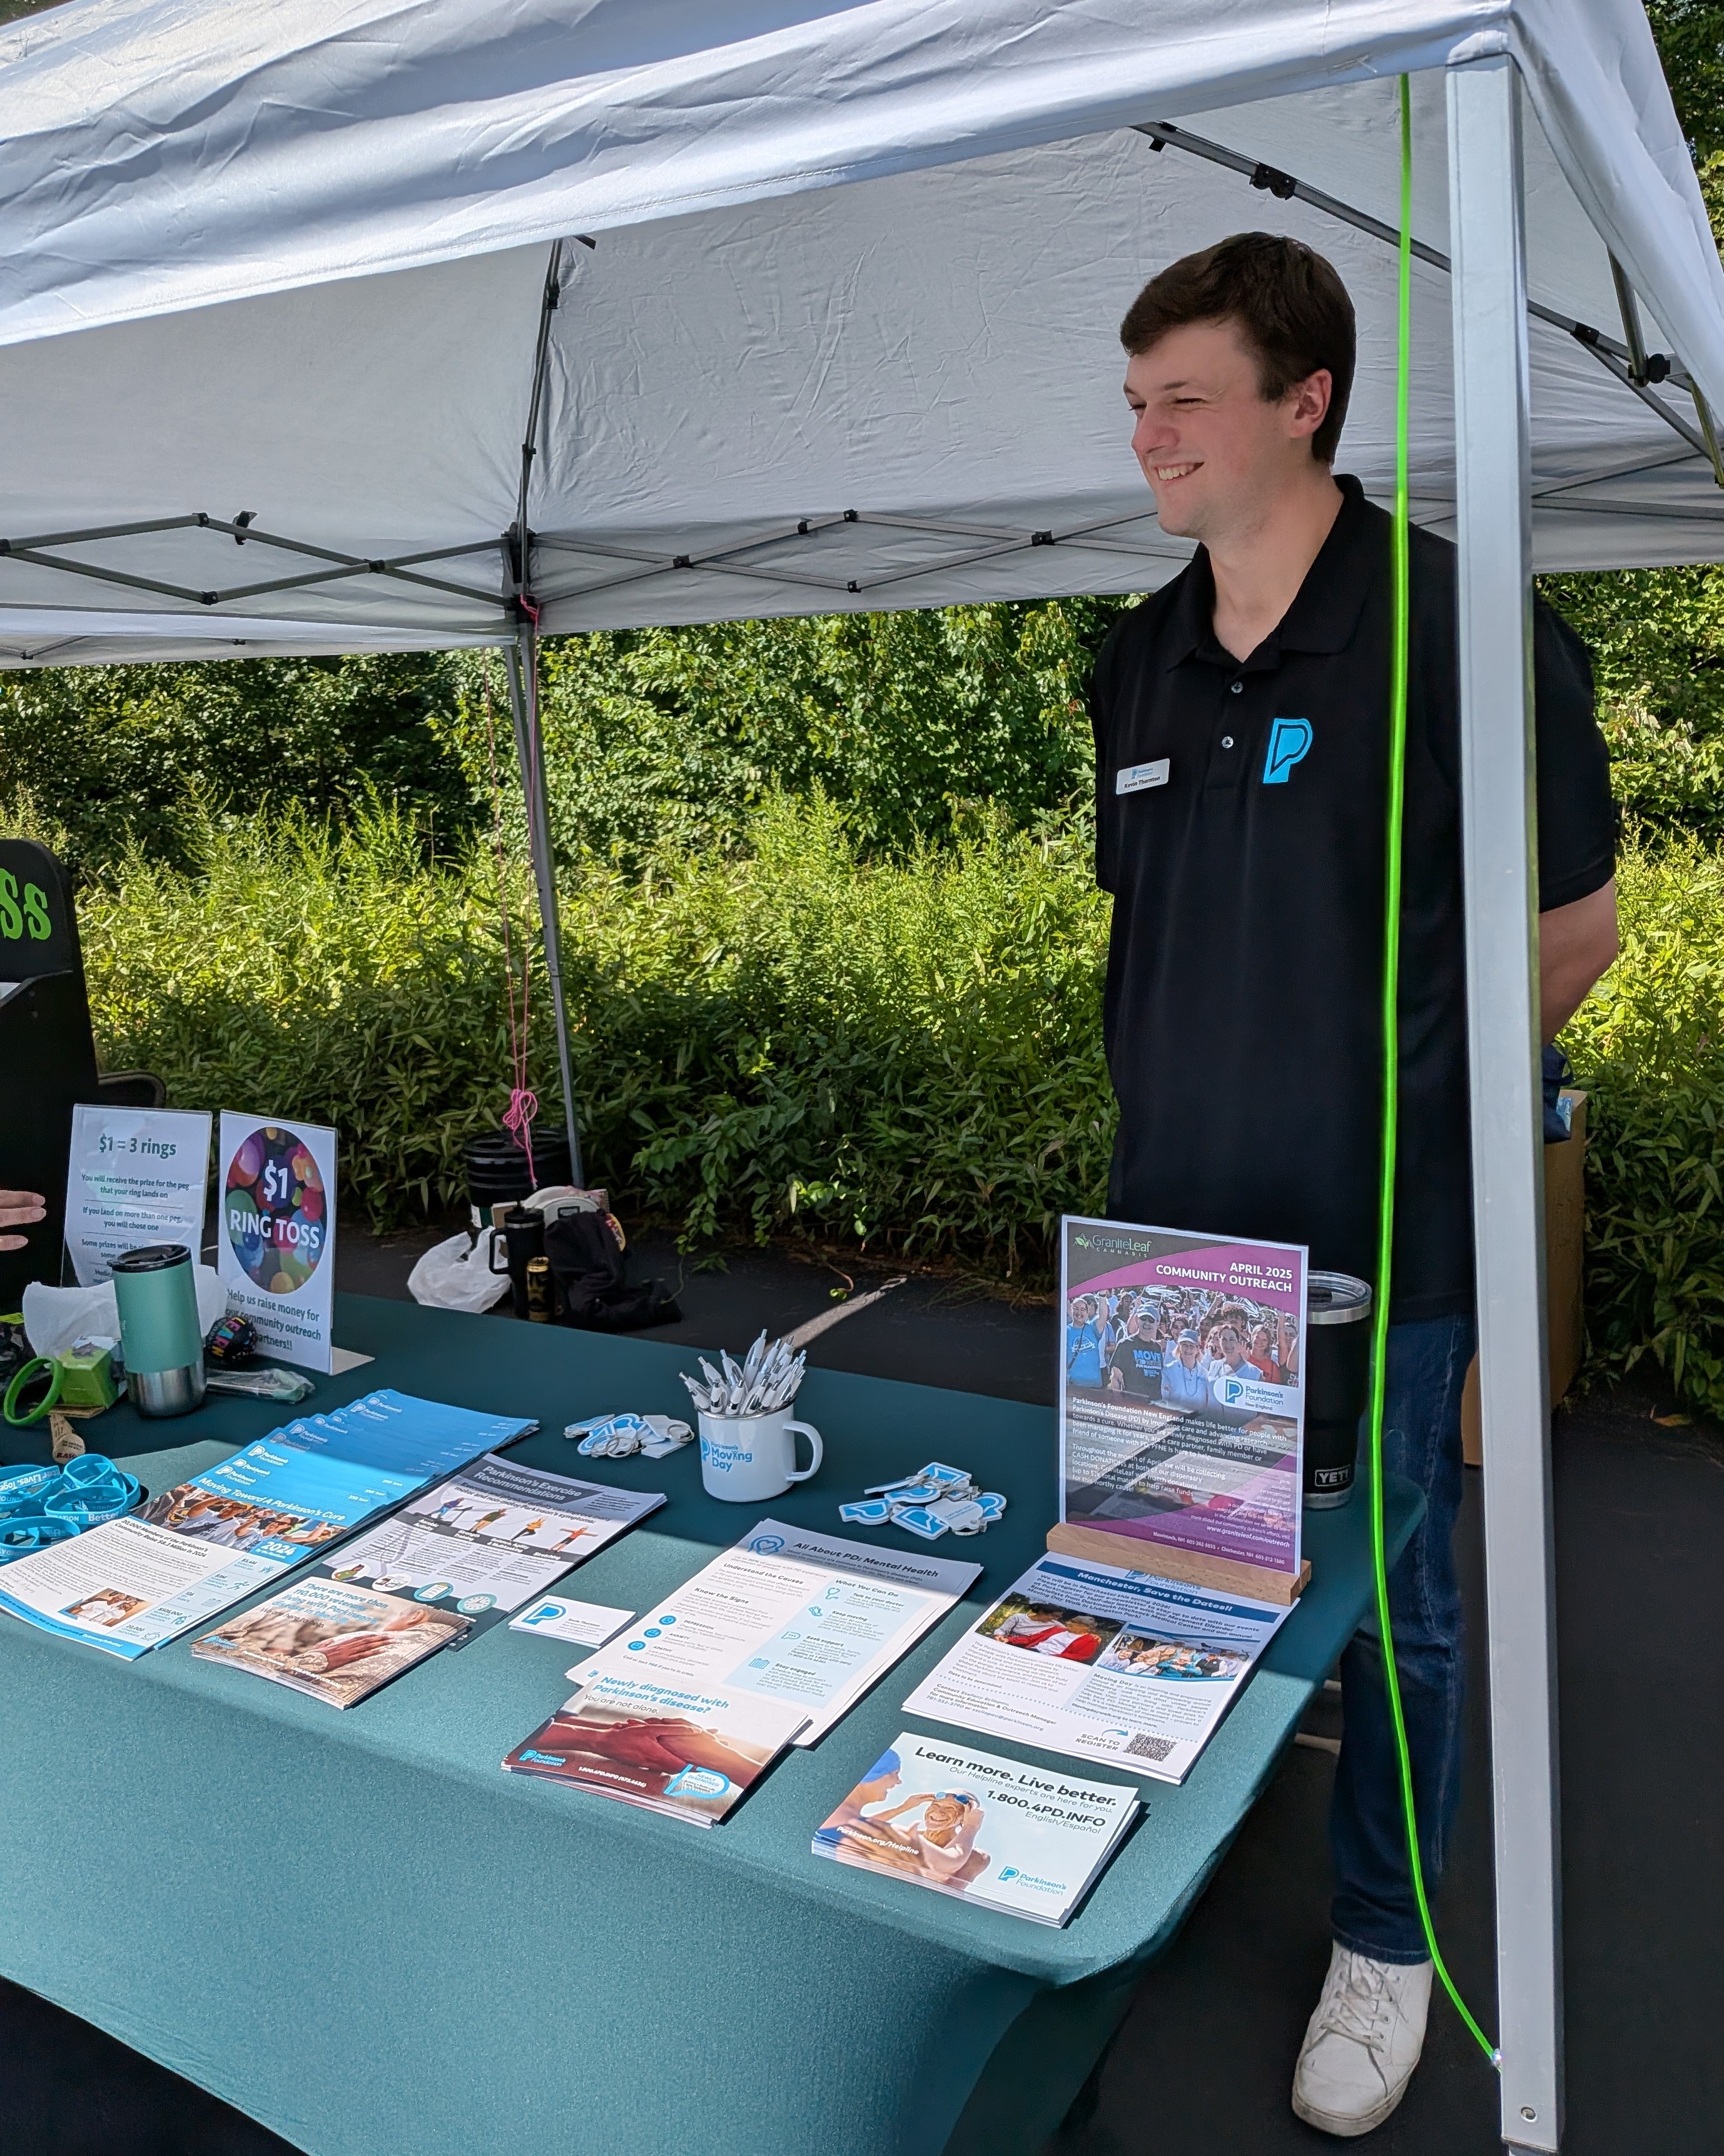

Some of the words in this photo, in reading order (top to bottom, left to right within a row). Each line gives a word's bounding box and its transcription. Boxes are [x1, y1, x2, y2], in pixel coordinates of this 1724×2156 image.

[1138, 776, 1160, 785] Thornton
[99, 1133, 113, 1153] $1
[129, 1138, 137, 1152] 3
[141, 1138, 176, 1159] rings
[140, 1178, 155, 1187] prize
[166, 1180, 176, 1188] the
[263, 1159, 288, 1201] $1
[129, 1189, 141, 1197] ring
[101, 1208, 114, 1216] land
[170, 1215, 183, 1223] peg,
[230, 1209, 271, 1238] RING
[275, 1219, 320, 1249] TOSS
[99, 1240, 116, 1249] prizes
[1092, 1234, 1151, 1252] GraniteLeaf
[1097, 1247, 1148, 1258] CANNABIS
[1156, 1264, 1226, 1283] COMMUNITY
[1229, 1275, 1292, 1293] OUTREACH
[1230, 1262, 1263, 1275] APRIL
[1265, 1267, 1292, 1279] 2025
[228, 1289, 245, 1304] Help
[247, 1296, 256, 1305] us
[258, 1298, 276, 1310] raise
[278, 1304, 305, 1321] money
[307, 1309, 320, 1321] for
[240, 1311, 285, 1332] community
[285, 1325, 321, 1340] outreach
[256, 1333, 292, 1350] artners!!
[1133, 1350, 1161, 1362] MOVE
[1245, 1385, 1284, 1398] Parkinson's
[1245, 1392, 1284, 1405] Foundation
[1072, 1397, 1106, 1408] Parkinson's
[1107, 1403, 1142, 1415] Foundation
[1143, 1410, 1158, 1418] New
[1159, 1413, 1184, 1423] England
[1206, 1420, 1216, 1428] life
[1217, 1423, 1236, 1432] better
[1249, 1430, 1270, 1439] people
[1072, 1405, 1104, 1416] Parkinson's
[1105, 1410, 1127, 1420] Disease
[1128, 1415, 1140, 1423] (PD)
[1150, 1418, 1180, 1431] improving
[1209, 1430, 1239, 1442] advancing
[1240, 1437, 1267, 1446] research
[712, 1447, 753, 1462] Moving
[712, 1457, 733, 1472] Day
[482, 1466, 539, 1487] Parkinson's
[538, 1482, 582, 1497] Exercise
[1319, 1469, 1349, 1483] YETI
[474, 1472, 565, 1500] Recommendations
[199, 1477, 232, 1494] Moving
[231, 1489, 265, 1503] Toward
[272, 1500, 322, 1516] Parkinson's
[322, 1512, 346, 1521] Cure
[260, 1541, 298, 1556] 2024
[809, 1545, 843, 1557] About
[843, 1553, 862, 1562] PD:
[863, 1557, 903, 1570] Mental
[901, 1565, 939, 1577] Health
[724, 1563, 765, 1575] Understand
[778, 1575, 804, 1584] Causes
[694, 1587, 716, 1595] Know
[835, 1579, 856, 1587] What
[293, 1589, 330, 1600] 110,000
[304, 1583, 328, 1592] There
[345, 1593, 367, 1602] more
[367, 1597, 388, 1609] than
[1077, 1572, 1140, 1593] Manchester,
[1143, 1587, 1170, 1599] Save
[1172, 1592, 1190, 1602] the
[1192, 1598, 1233, 1612] Dates!!
[592, 1685, 659, 1702] Parkinson's
[659, 1697, 712, 1714] disease?
[601, 1677, 639, 1689] Newly
[639, 1683, 701, 1702] diagnosed
[701, 1696, 729, 1709] with
[633, 1704, 658, 1714] alone.
[1075, 1738, 1118, 1751] REGISTER
[1081, 1733, 1107, 1742] SCAN
[915, 1746, 964, 1767] Learn
[965, 1761, 1014, 1781] more.
[1018, 1774, 1055, 1792] Live
[1056, 1784, 1117, 1806] better.
[950, 1767, 966, 1776] Our
[968, 1771, 1003, 1786] Helpline
[1005, 1782, 1039, 1798] experts
[1040, 1792, 1055, 1801] are
[1057, 1795, 1078, 1807] here
[1079, 1801, 1093, 1809] for
[1094, 1805, 1113, 1814] you.
[986, 1790, 1106, 1826] 1.800.4PD.INFO
[1025, 1811, 1102, 1834] English/Español
[837, 1826, 919, 1855] Parkinson.org/Helpline
[1016, 1879, 1063, 1896] Foundation
[1018, 1873, 1067, 1890] Parkinson's
